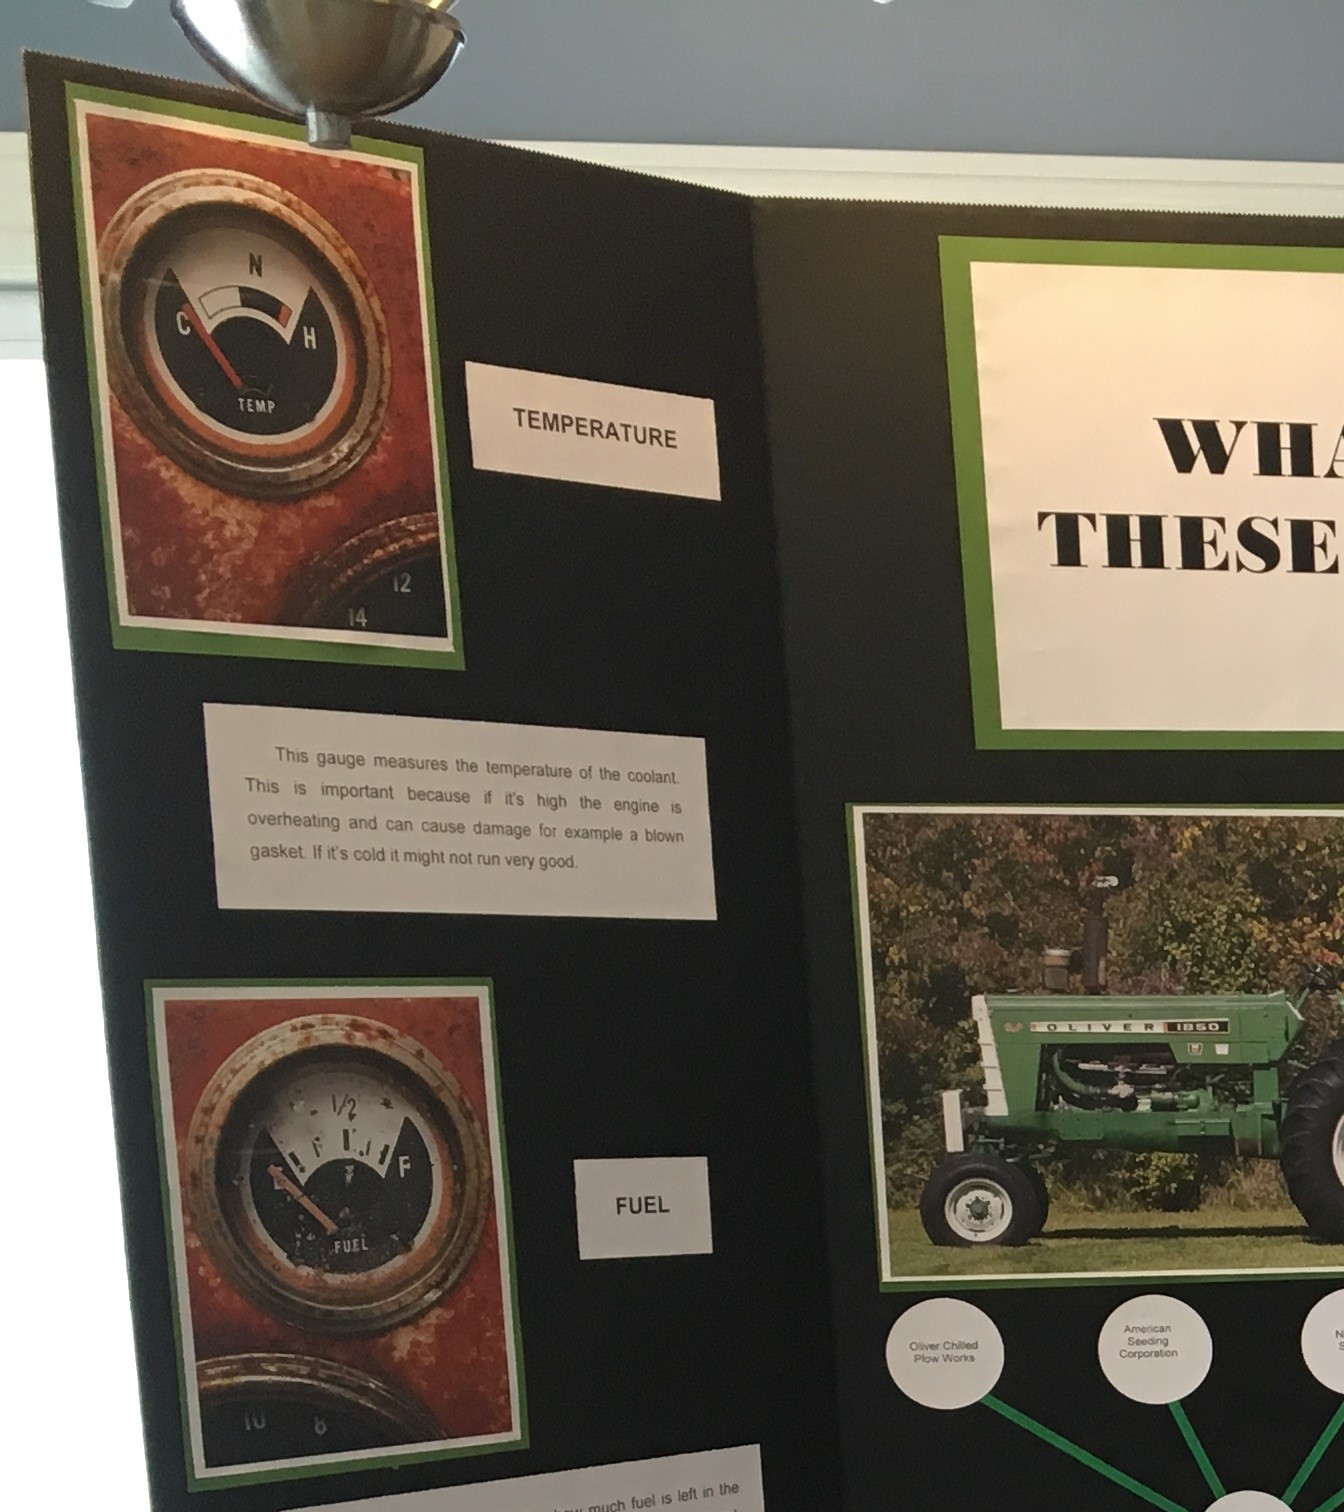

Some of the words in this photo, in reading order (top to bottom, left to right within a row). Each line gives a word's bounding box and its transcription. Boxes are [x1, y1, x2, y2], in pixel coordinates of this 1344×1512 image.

[249, 252, 262, 277] N
[176, 312, 190, 335] C
[303, 326, 316, 350] H
[238, 397, 276, 414] TEMP
[512, 406, 678, 449] TEMPERATURE
[1037, 511, 1339, 574] THESE
[394, 572, 412, 592] 12
[274, 745, 309, 764] This
[316, 752, 366, 770] gauge
[373, 755, 449, 772] measures
[454, 757, 479, 774] the
[485, 760, 573, 779] temperature
[578, 764, 593, 780] of
[598, 766, 621, 782] the
[1046, 1022, 1154, 1032] OLIVER
[332, 1094, 357, 1122] 1/2
[398, 1156, 411, 1178] F
[616, 1194, 671, 1216] FUEL
[334, 1238, 368, 1254] FUEL
[1124, 1325, 1171, 1333] American
[909, 1341, 940, 1351] Oliver
[943, 1340, 978, 1350] Chilled
[1128, 1337, 1168, 1347] Seeding
[914, 1354, 938, 1363] Plow
[943, 1354, 976, 1362] Works
[1119, 1349, 1178, 1360] Corporation
